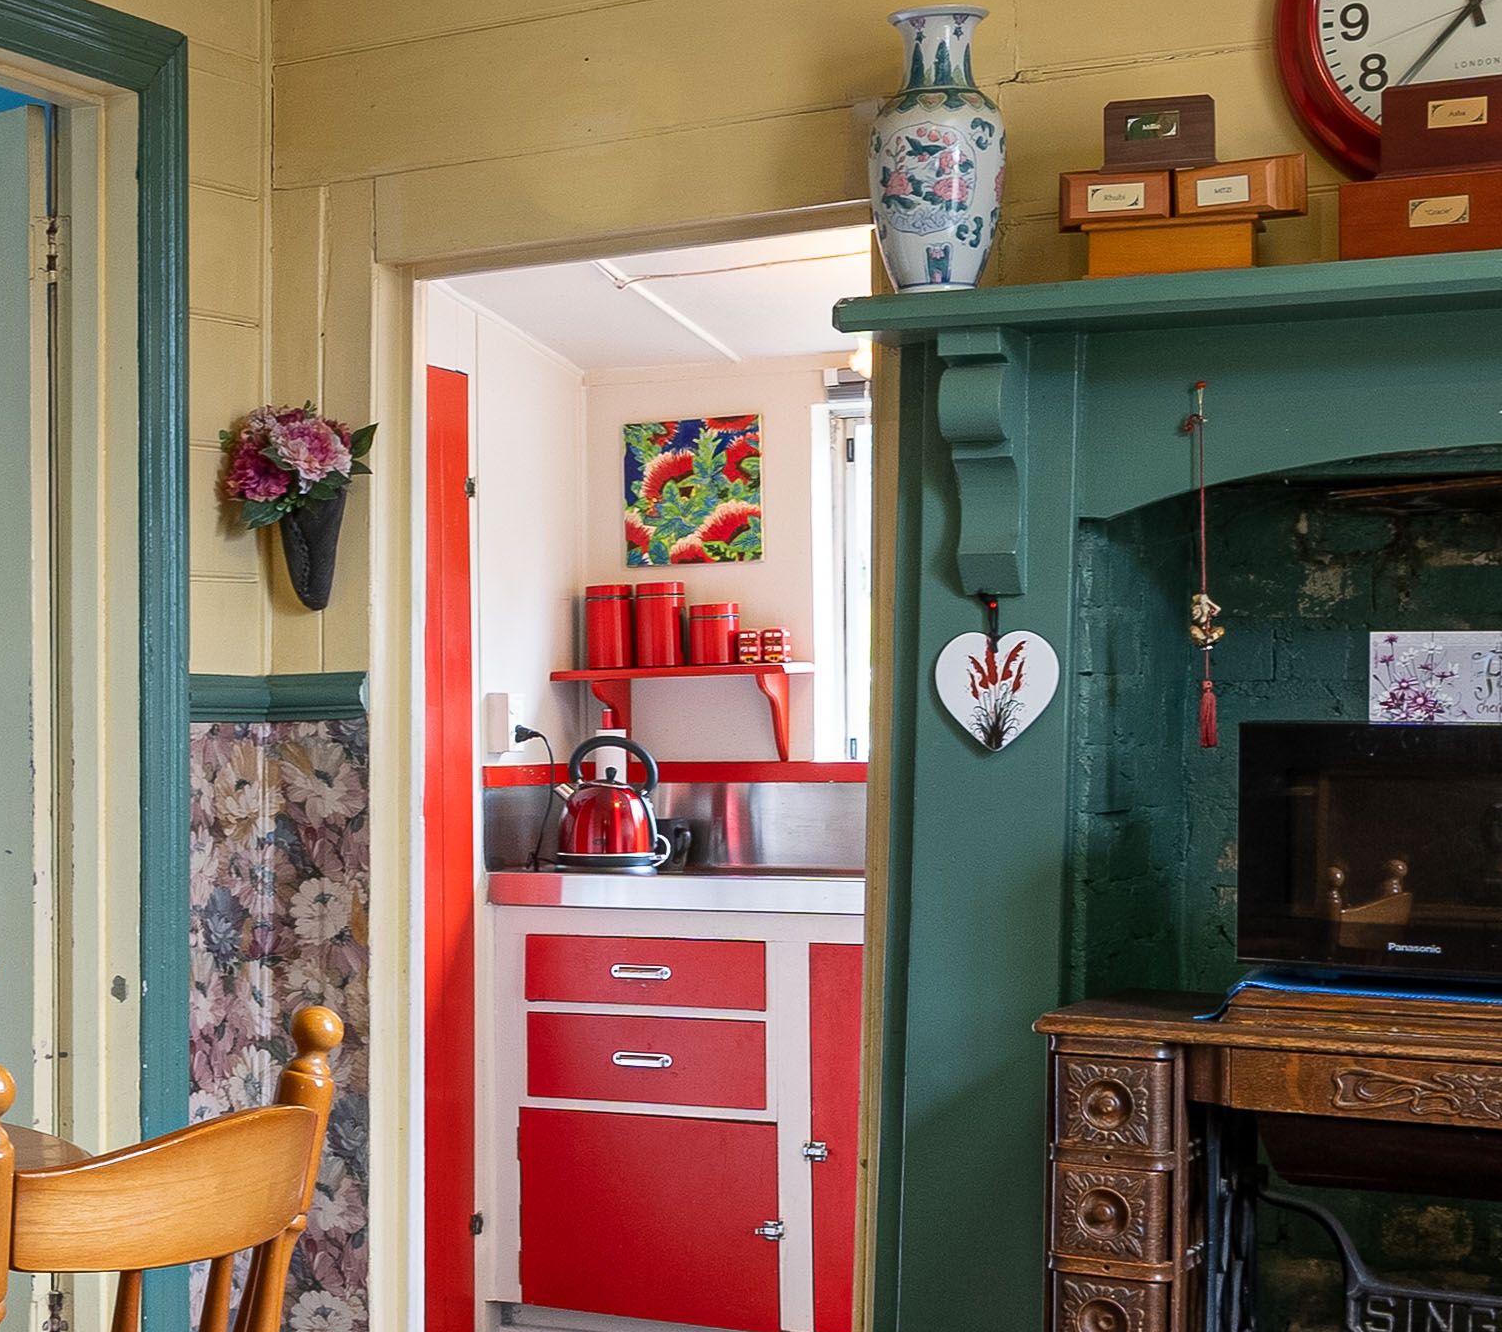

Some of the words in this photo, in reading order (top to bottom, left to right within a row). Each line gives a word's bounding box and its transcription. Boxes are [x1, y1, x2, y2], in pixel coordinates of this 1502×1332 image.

[1339, 2, 1369, 42] 9
[1358, 53, 1389, 92] 8
[1454, 56, 1501, 69] LONDON
[1387, 942, 1442, 954] Panasonic
